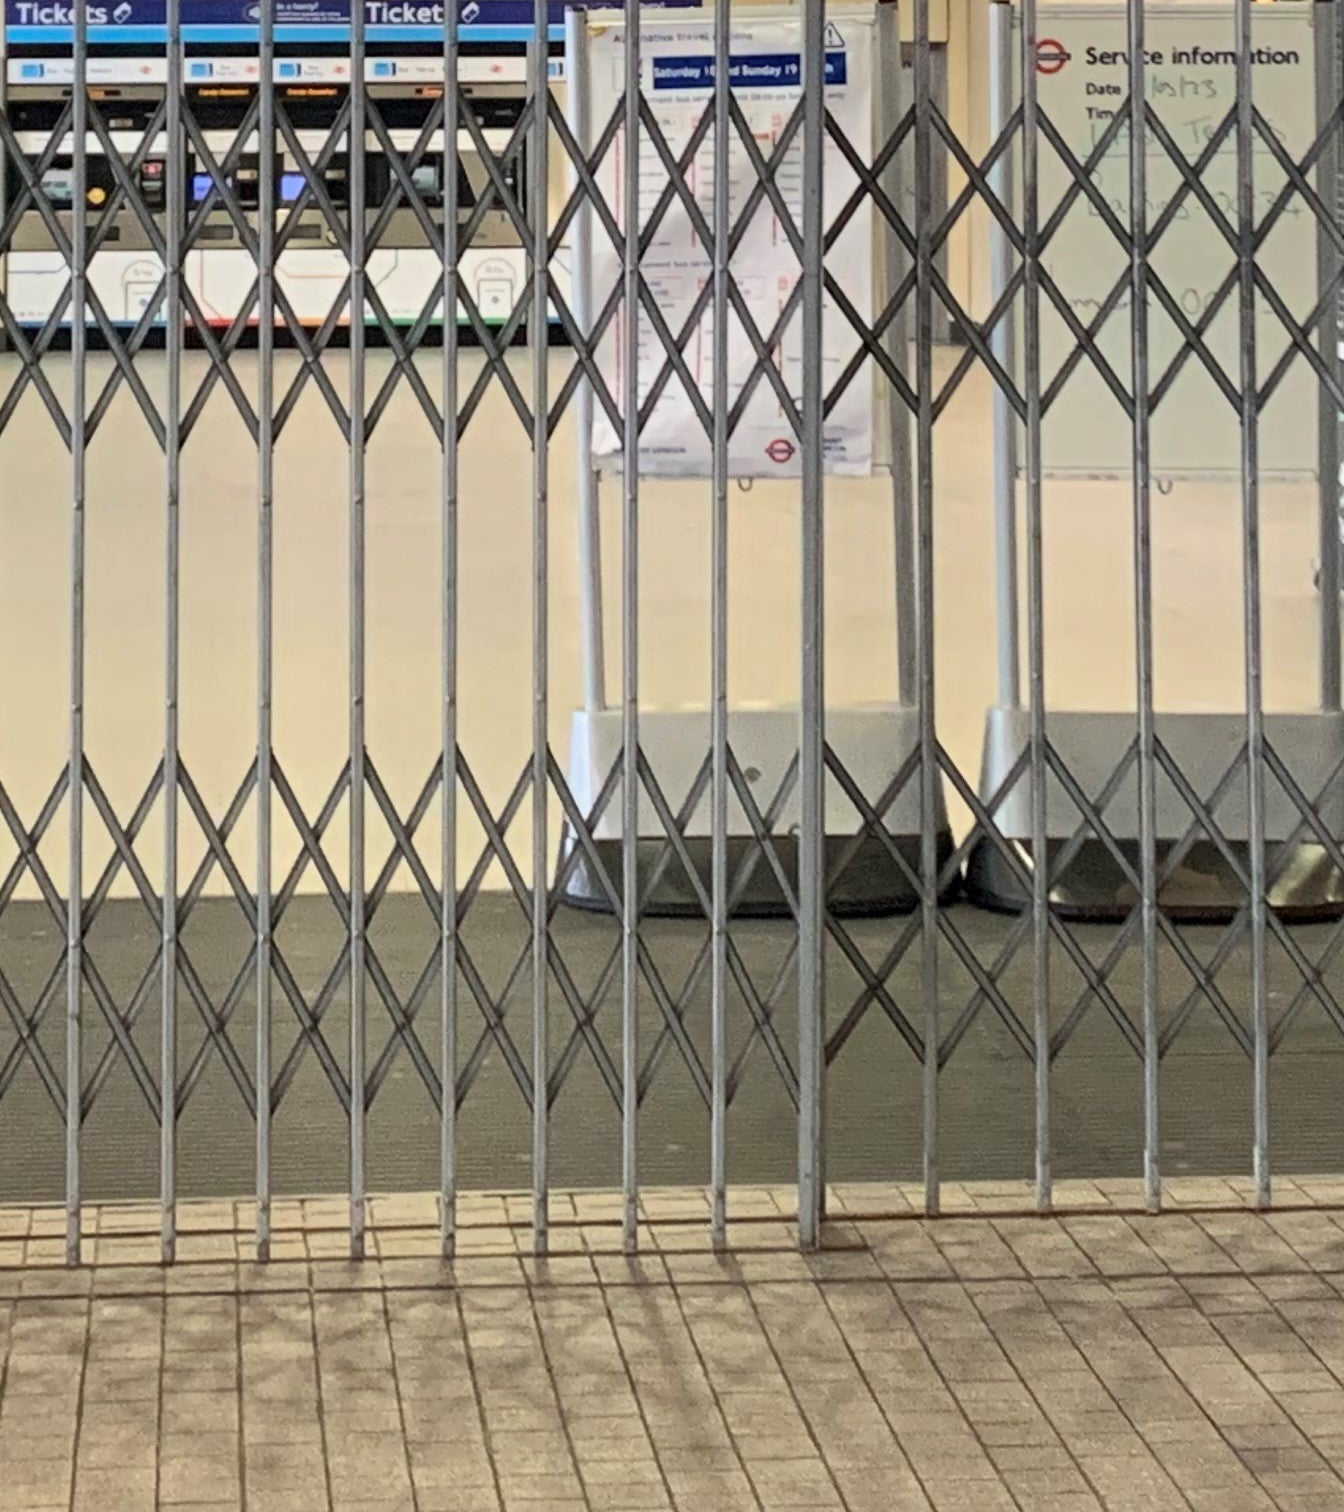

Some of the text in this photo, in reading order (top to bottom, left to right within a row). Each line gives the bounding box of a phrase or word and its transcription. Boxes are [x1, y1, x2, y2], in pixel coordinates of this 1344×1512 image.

[365, 1, 445, 24] Ticket
[1085, 46, 1300, 66] Serve informtion
[1085, 82, 1121, 96] Date
[1085, 106, 1114, 120] Tim
